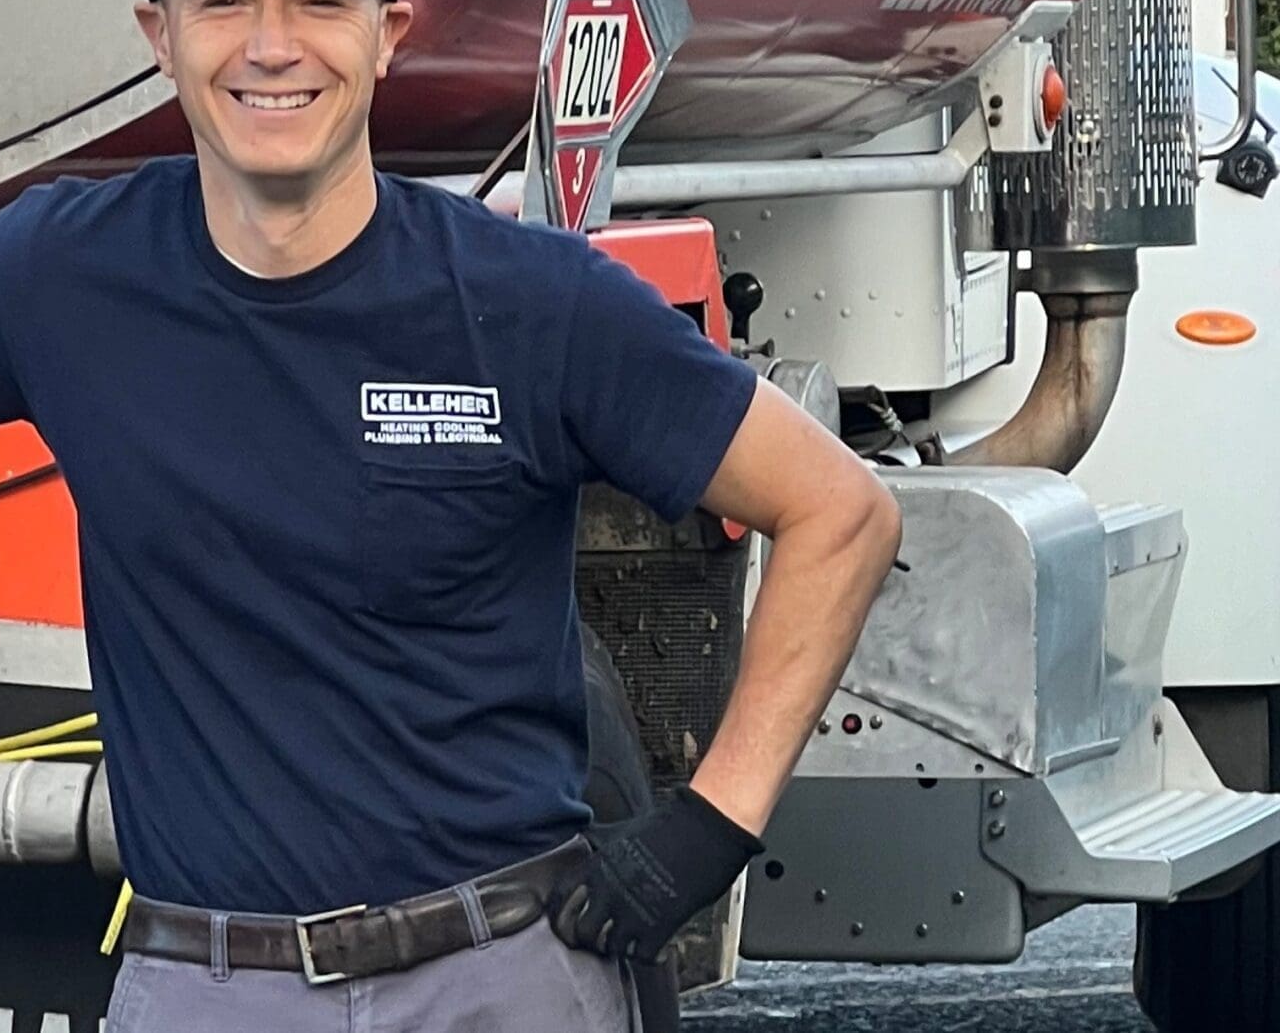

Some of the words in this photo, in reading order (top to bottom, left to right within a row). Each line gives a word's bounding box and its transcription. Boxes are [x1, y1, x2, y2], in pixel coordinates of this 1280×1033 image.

[562, 20, 621, 118] 1202
[572, 147, 586, 195] 3
[370, 392, 490, 416] KELLEHER
[364, 432, 421, 444] PLUMBING
[434, 432, 503, 444] ELECTRICAL
[380, 422, 429, 433] HEATING
[434, 422, 485, 434] COOLING
